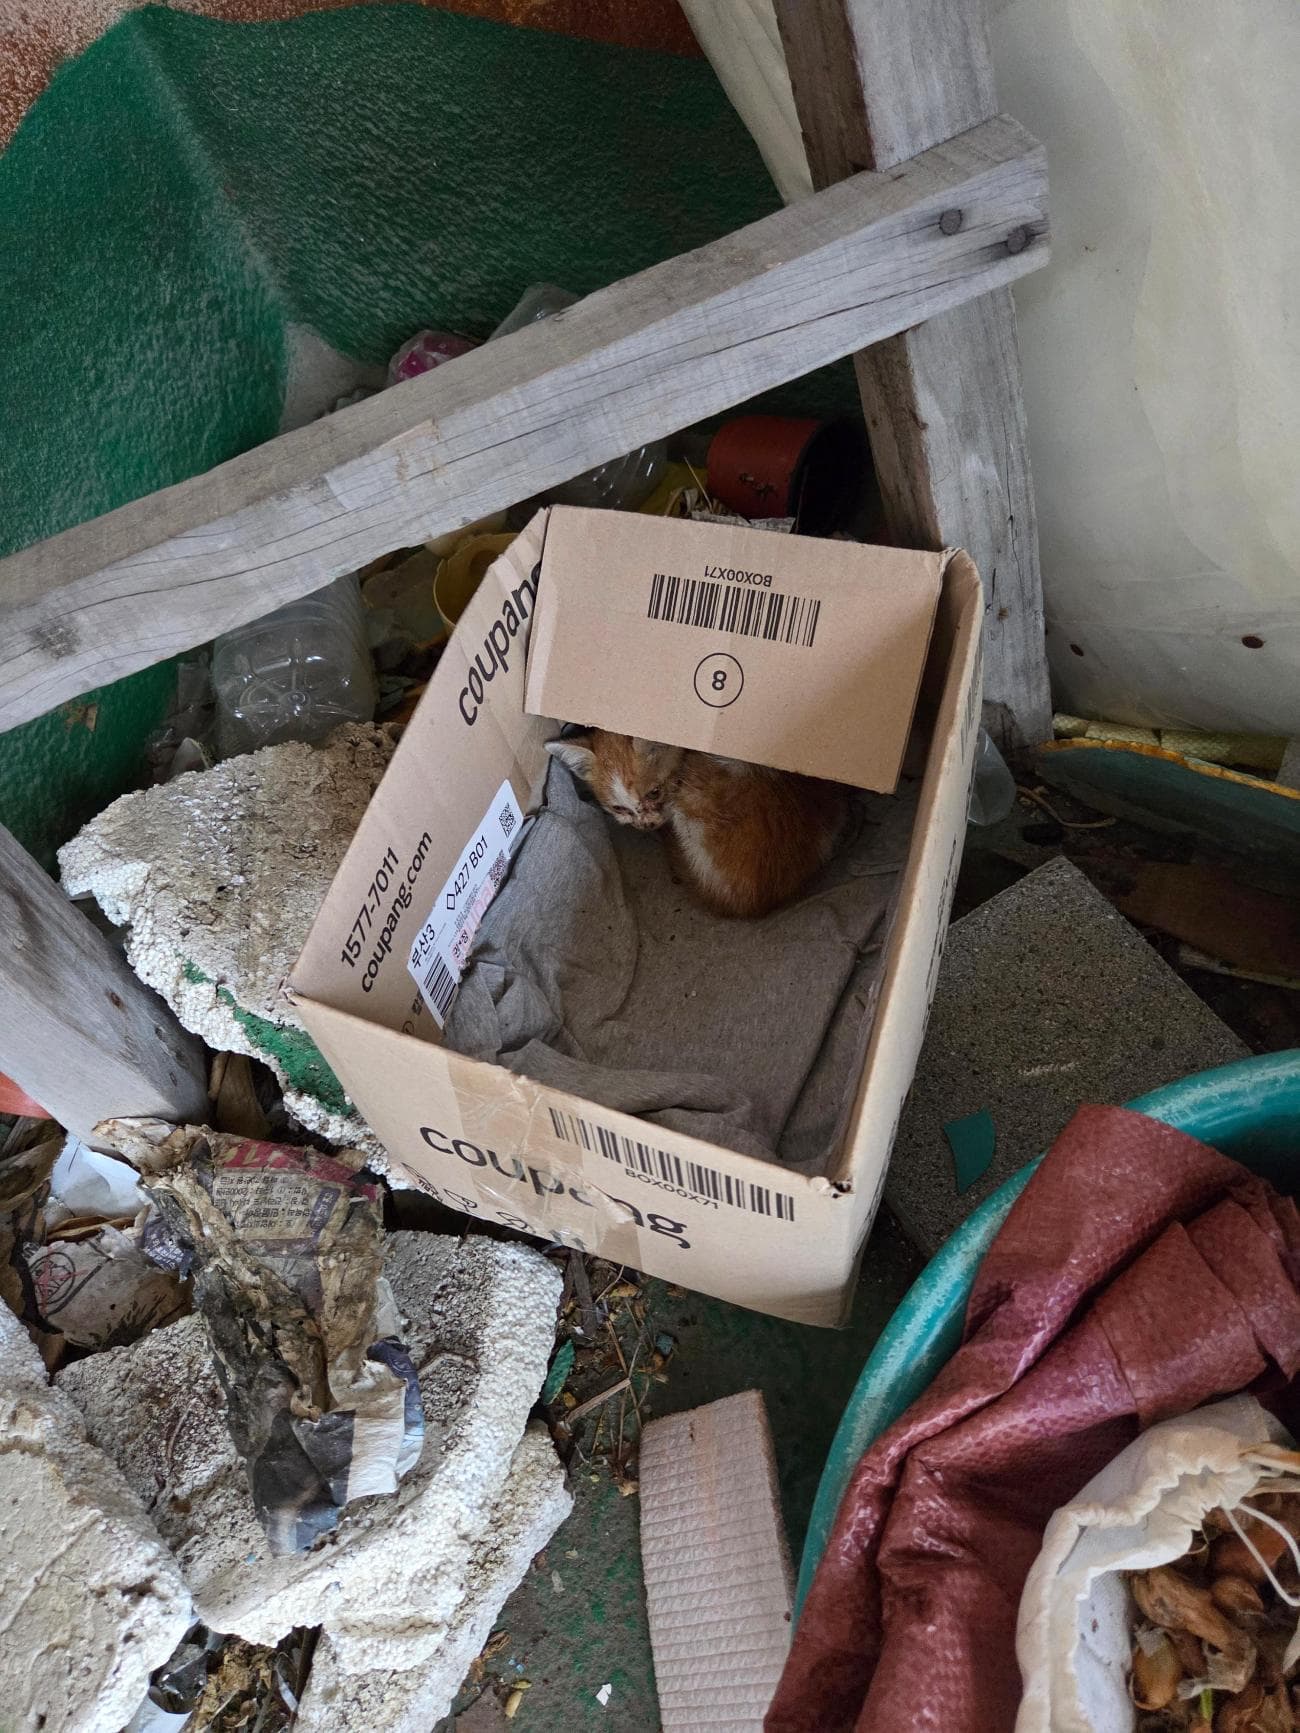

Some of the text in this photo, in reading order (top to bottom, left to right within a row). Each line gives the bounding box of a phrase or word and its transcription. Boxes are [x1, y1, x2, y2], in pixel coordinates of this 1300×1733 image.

[704, 565, 773, 588] BOX00X71
[711, 669, 727, 691] 8
[454, 863, 471, 897] 427
[468, 834, 489, 870] B01
[341, 846, 399, 968] 1577-7011
[361, 831, 433, 993] coupang.com
[411, 923, 436, 970] 부산3
[624, 1167, 720, 1210] BOX00X71
